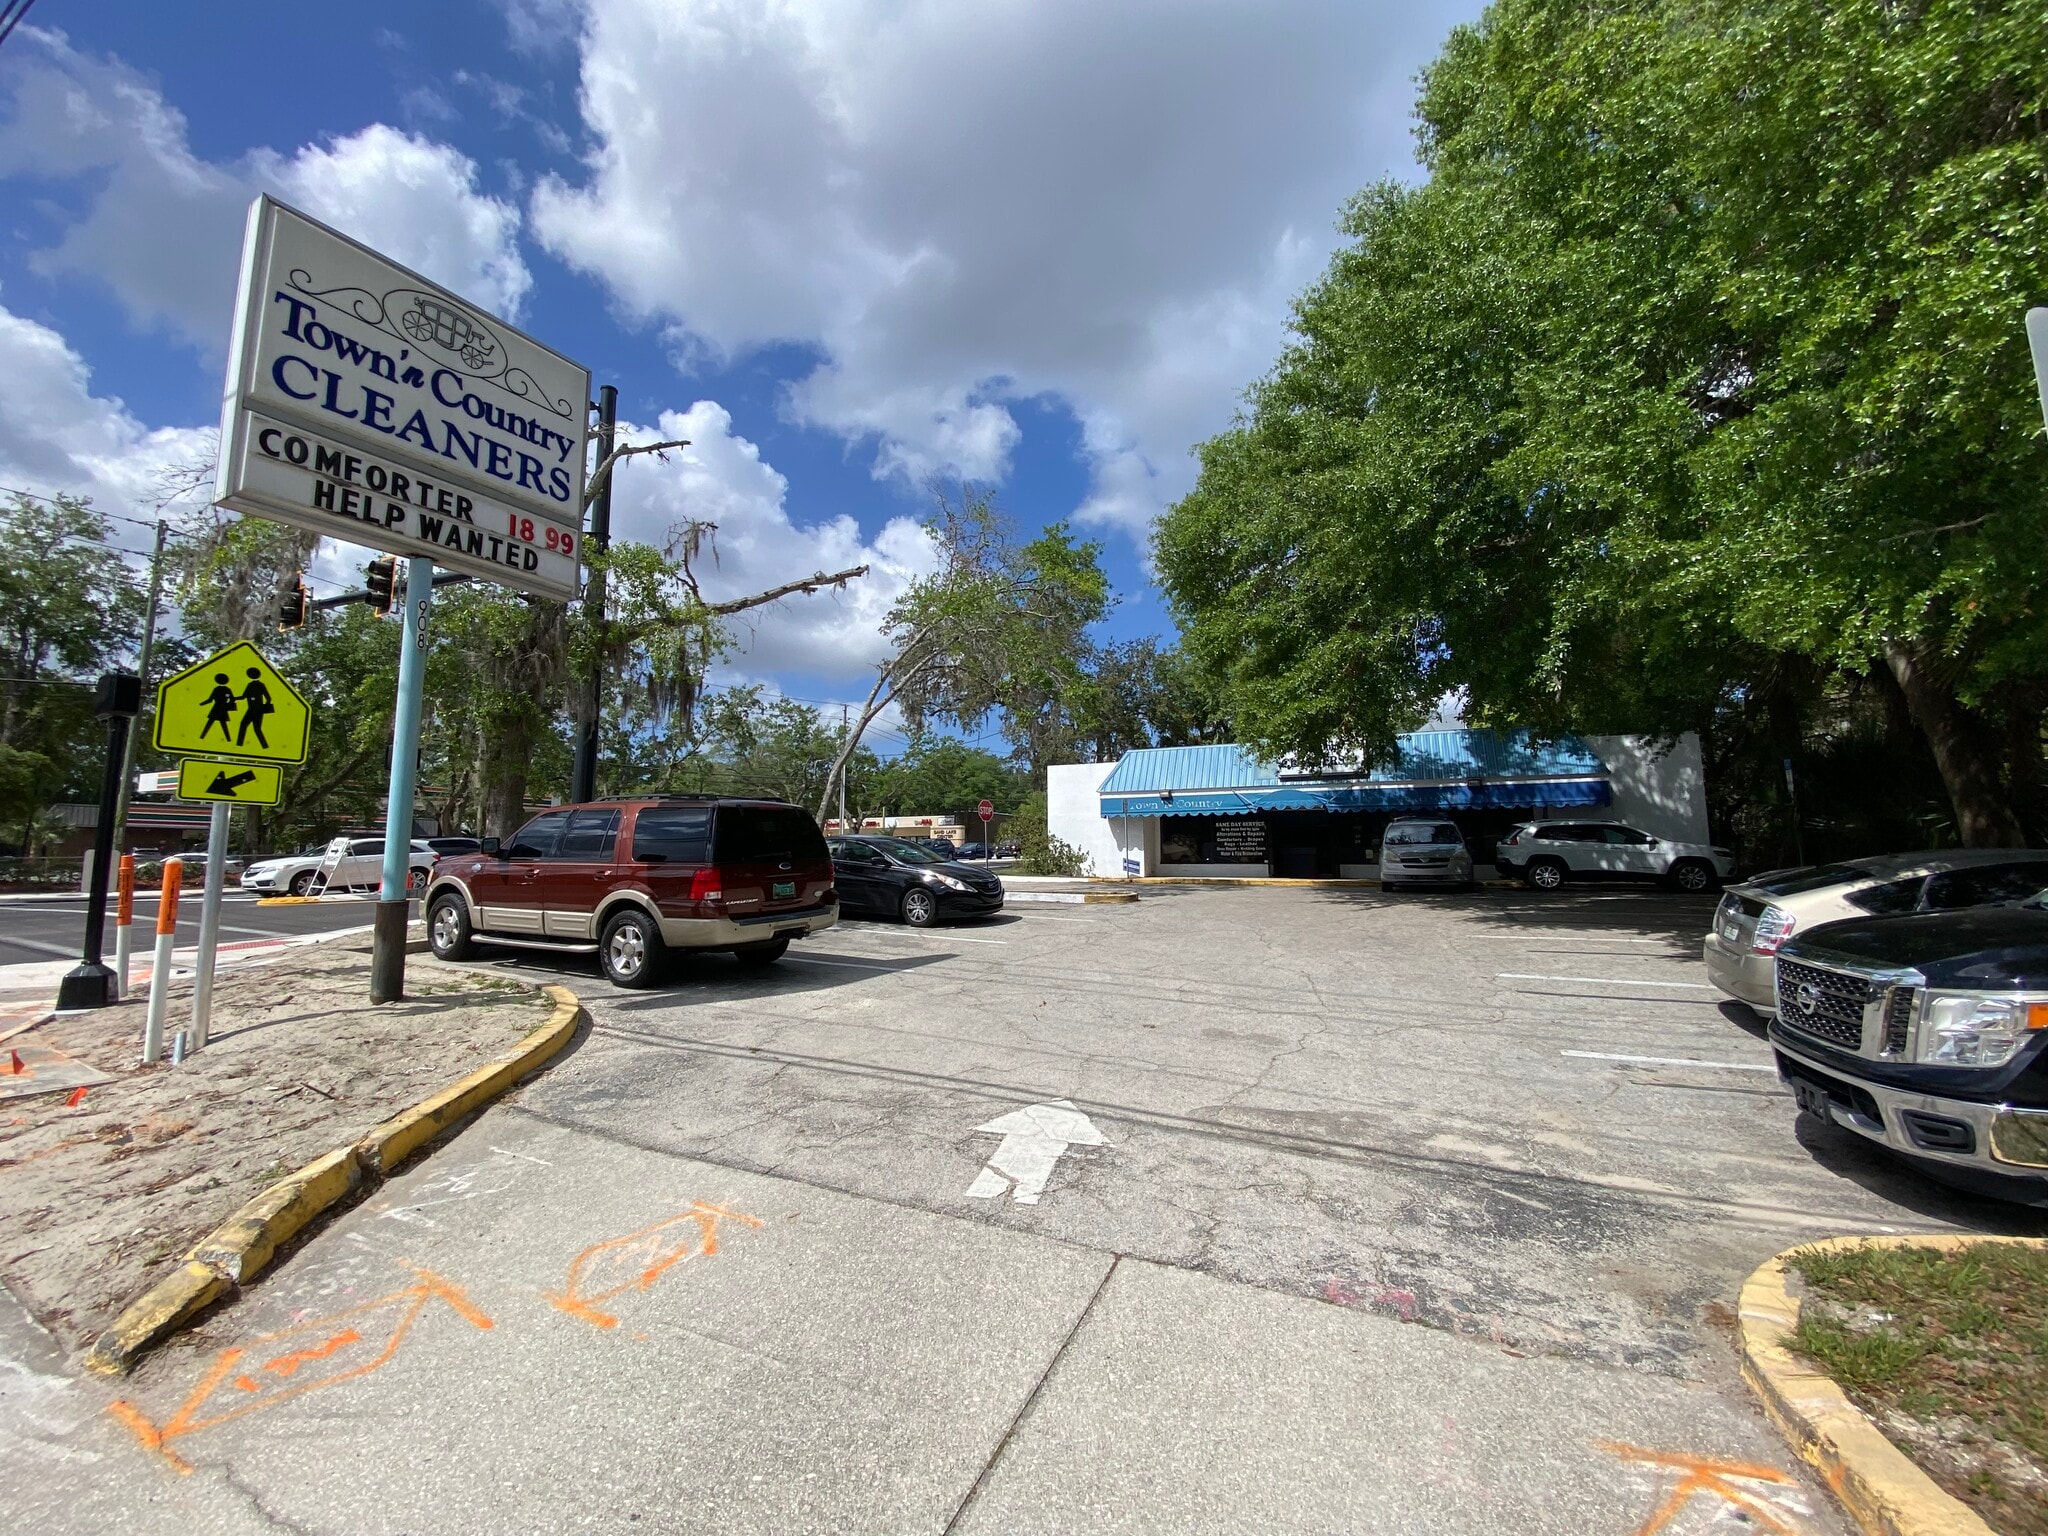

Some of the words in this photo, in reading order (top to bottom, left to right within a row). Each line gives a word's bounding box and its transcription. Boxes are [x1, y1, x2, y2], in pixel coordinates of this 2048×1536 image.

[272, 355, 570, 502] CLEANERS
[431, 369, 575, 463] Country
[259, 429, 474, 526] COMFORTER
[508, 513, 534, 542] 18
[545, 527, 574, 555] 99
[314, 480, 405, 528] HELP
[418, 514, 539, 571] WANTED
[417, 600, 428, 649] 908
[980, 807, 992, 815] STOP
[1176, 799, 1223, 810] Country
